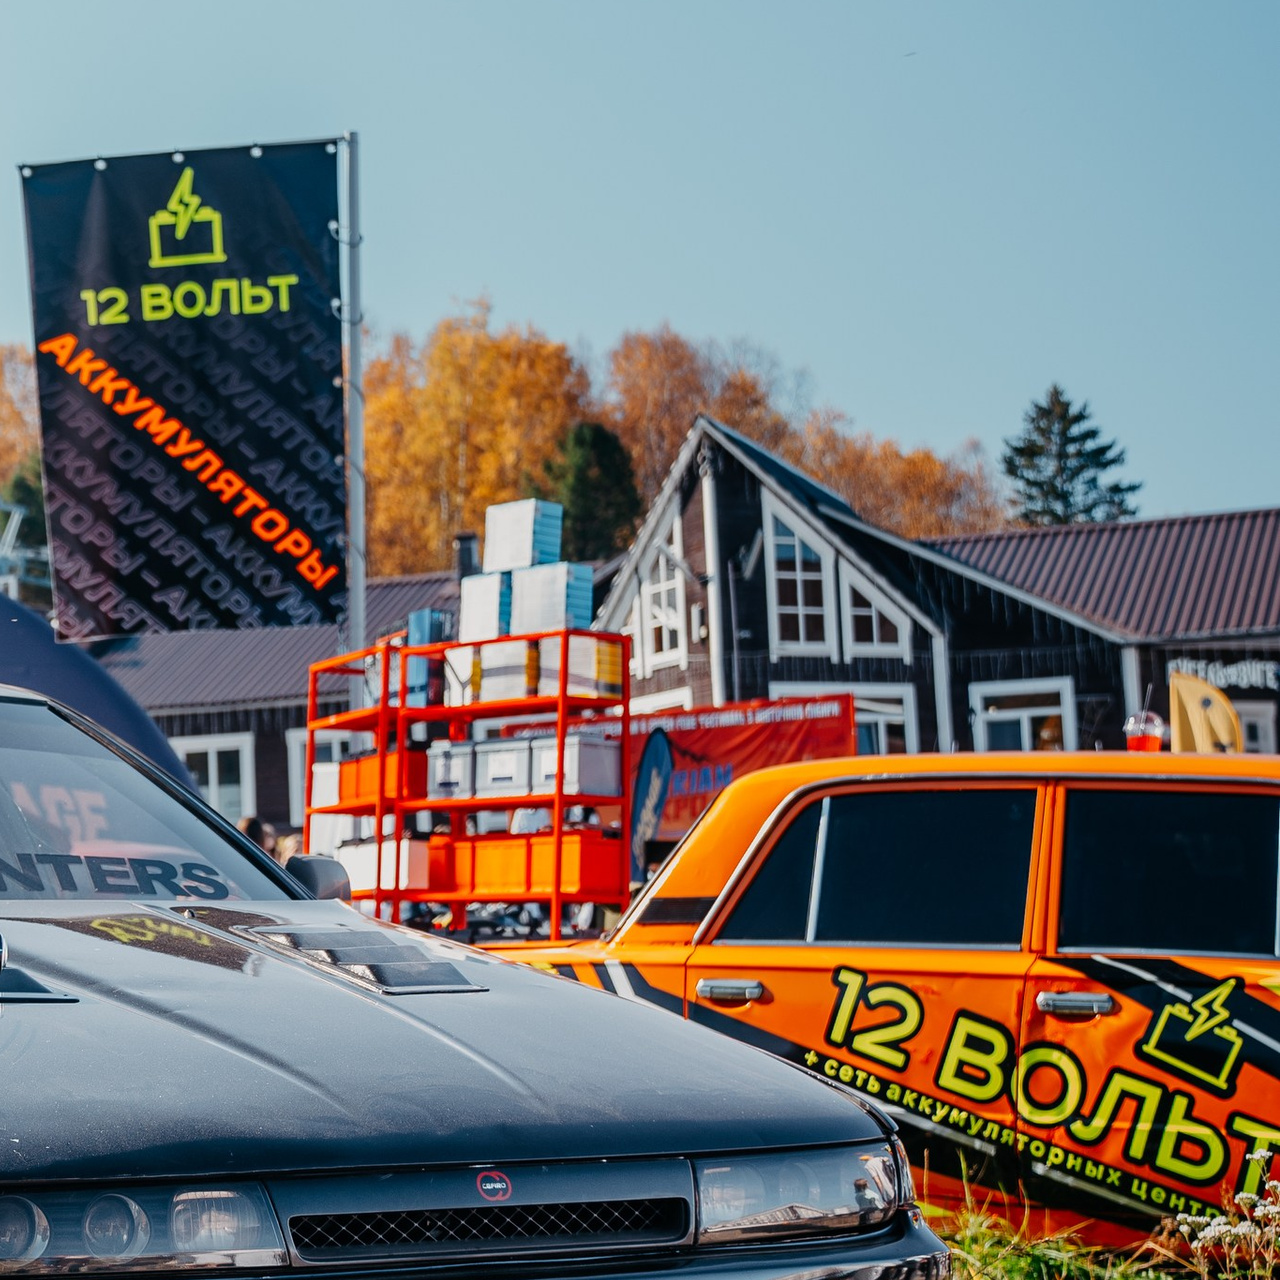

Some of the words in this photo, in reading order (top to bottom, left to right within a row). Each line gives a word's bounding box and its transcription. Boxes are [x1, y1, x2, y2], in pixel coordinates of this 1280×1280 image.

[80, 287, 130, 327] 12
[141, 274, 299, 322] ВОЛЬТ
[38, 332, 340, 591] АККУМУЛЯТОРЫ
[824, 1059, 881, 1094] сеть
[886, 1083, 1122, 1187] аккумуляторных
[830, 968, 921, 1069] 12
[938, 1016, 1280, 1196] ВОЛЬТ
